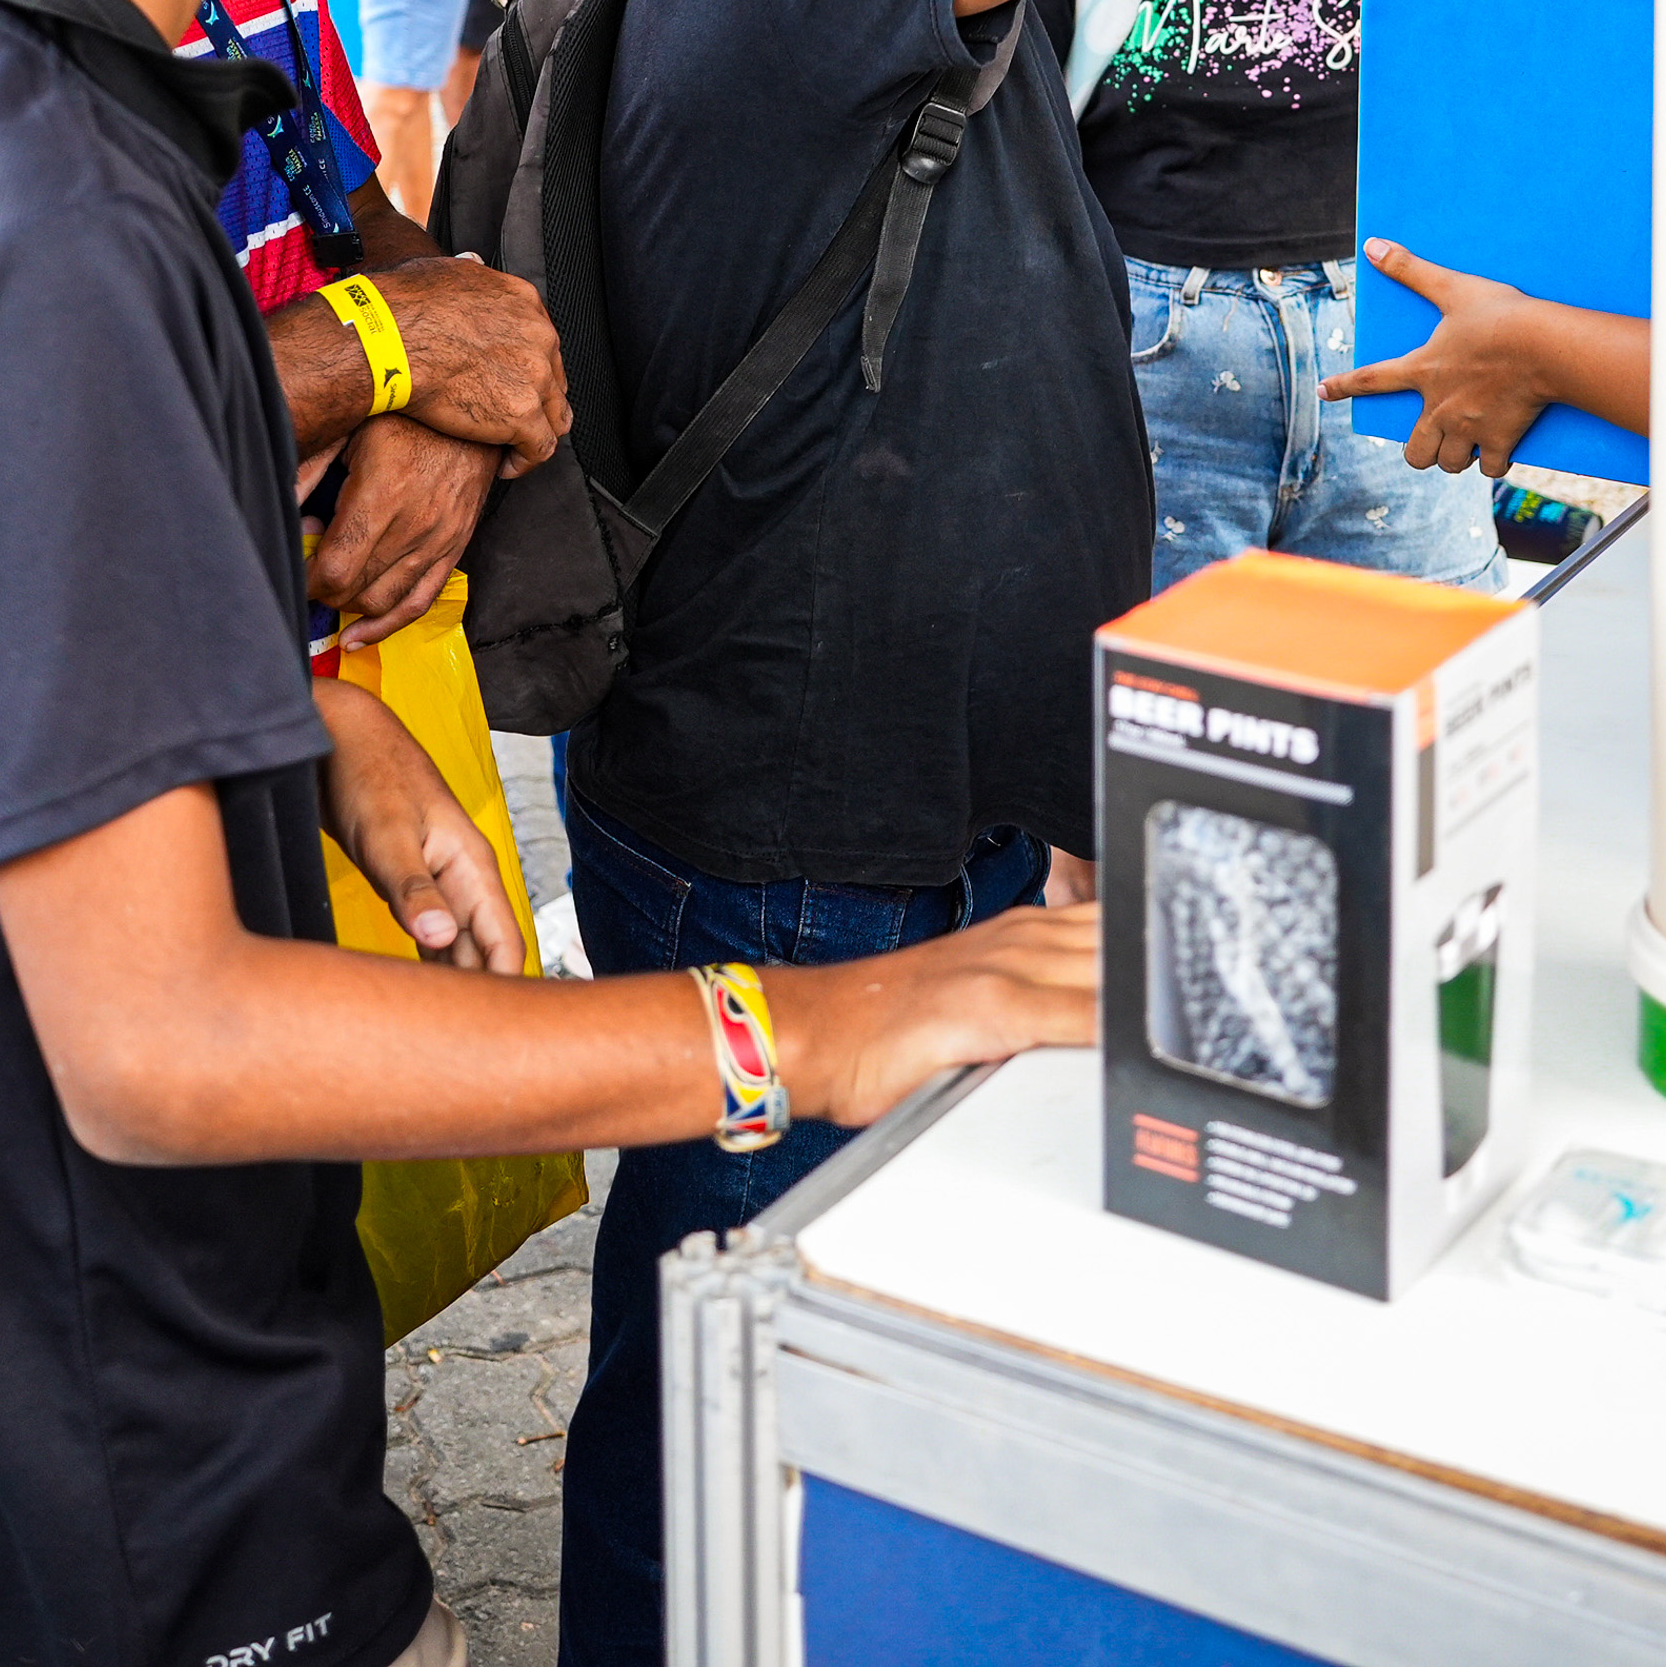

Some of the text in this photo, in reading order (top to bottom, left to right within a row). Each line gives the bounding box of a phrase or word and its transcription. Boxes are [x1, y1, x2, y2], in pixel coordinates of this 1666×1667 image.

[303, 184, 312, 196] CE
[359, 307, 377, 335] social
[1108, 683, 1205, 738] BEER
[1206, 706, 1320, 765] PINTS
[287, 1611, 332, 1652] FIT
